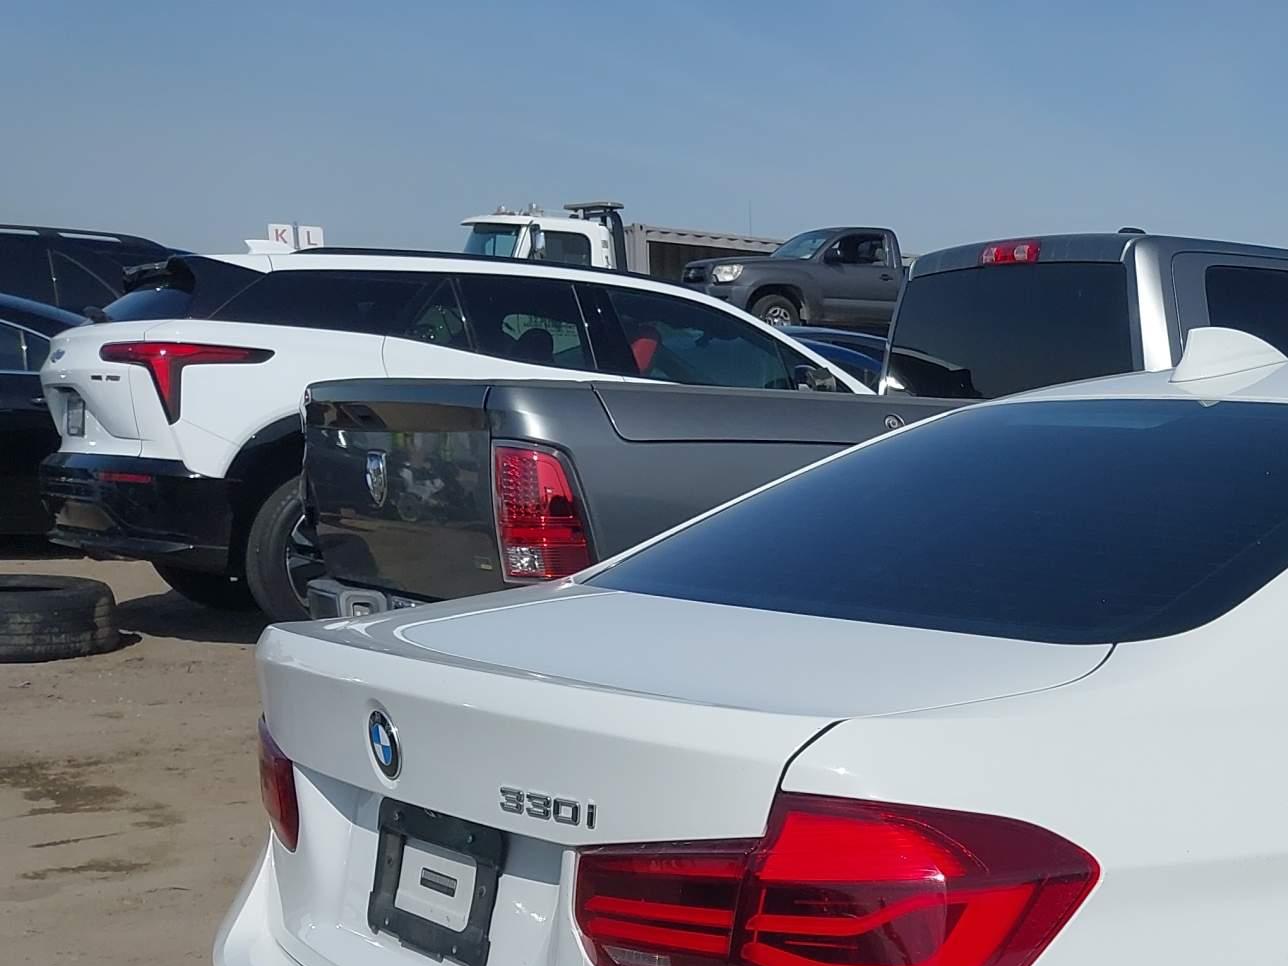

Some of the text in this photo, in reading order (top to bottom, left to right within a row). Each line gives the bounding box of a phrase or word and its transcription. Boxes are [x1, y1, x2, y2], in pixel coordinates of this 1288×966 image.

[275, 228, 288, 244] K
[306, 230, 318, 246] L
[499, 786, 597, 830] 330i
